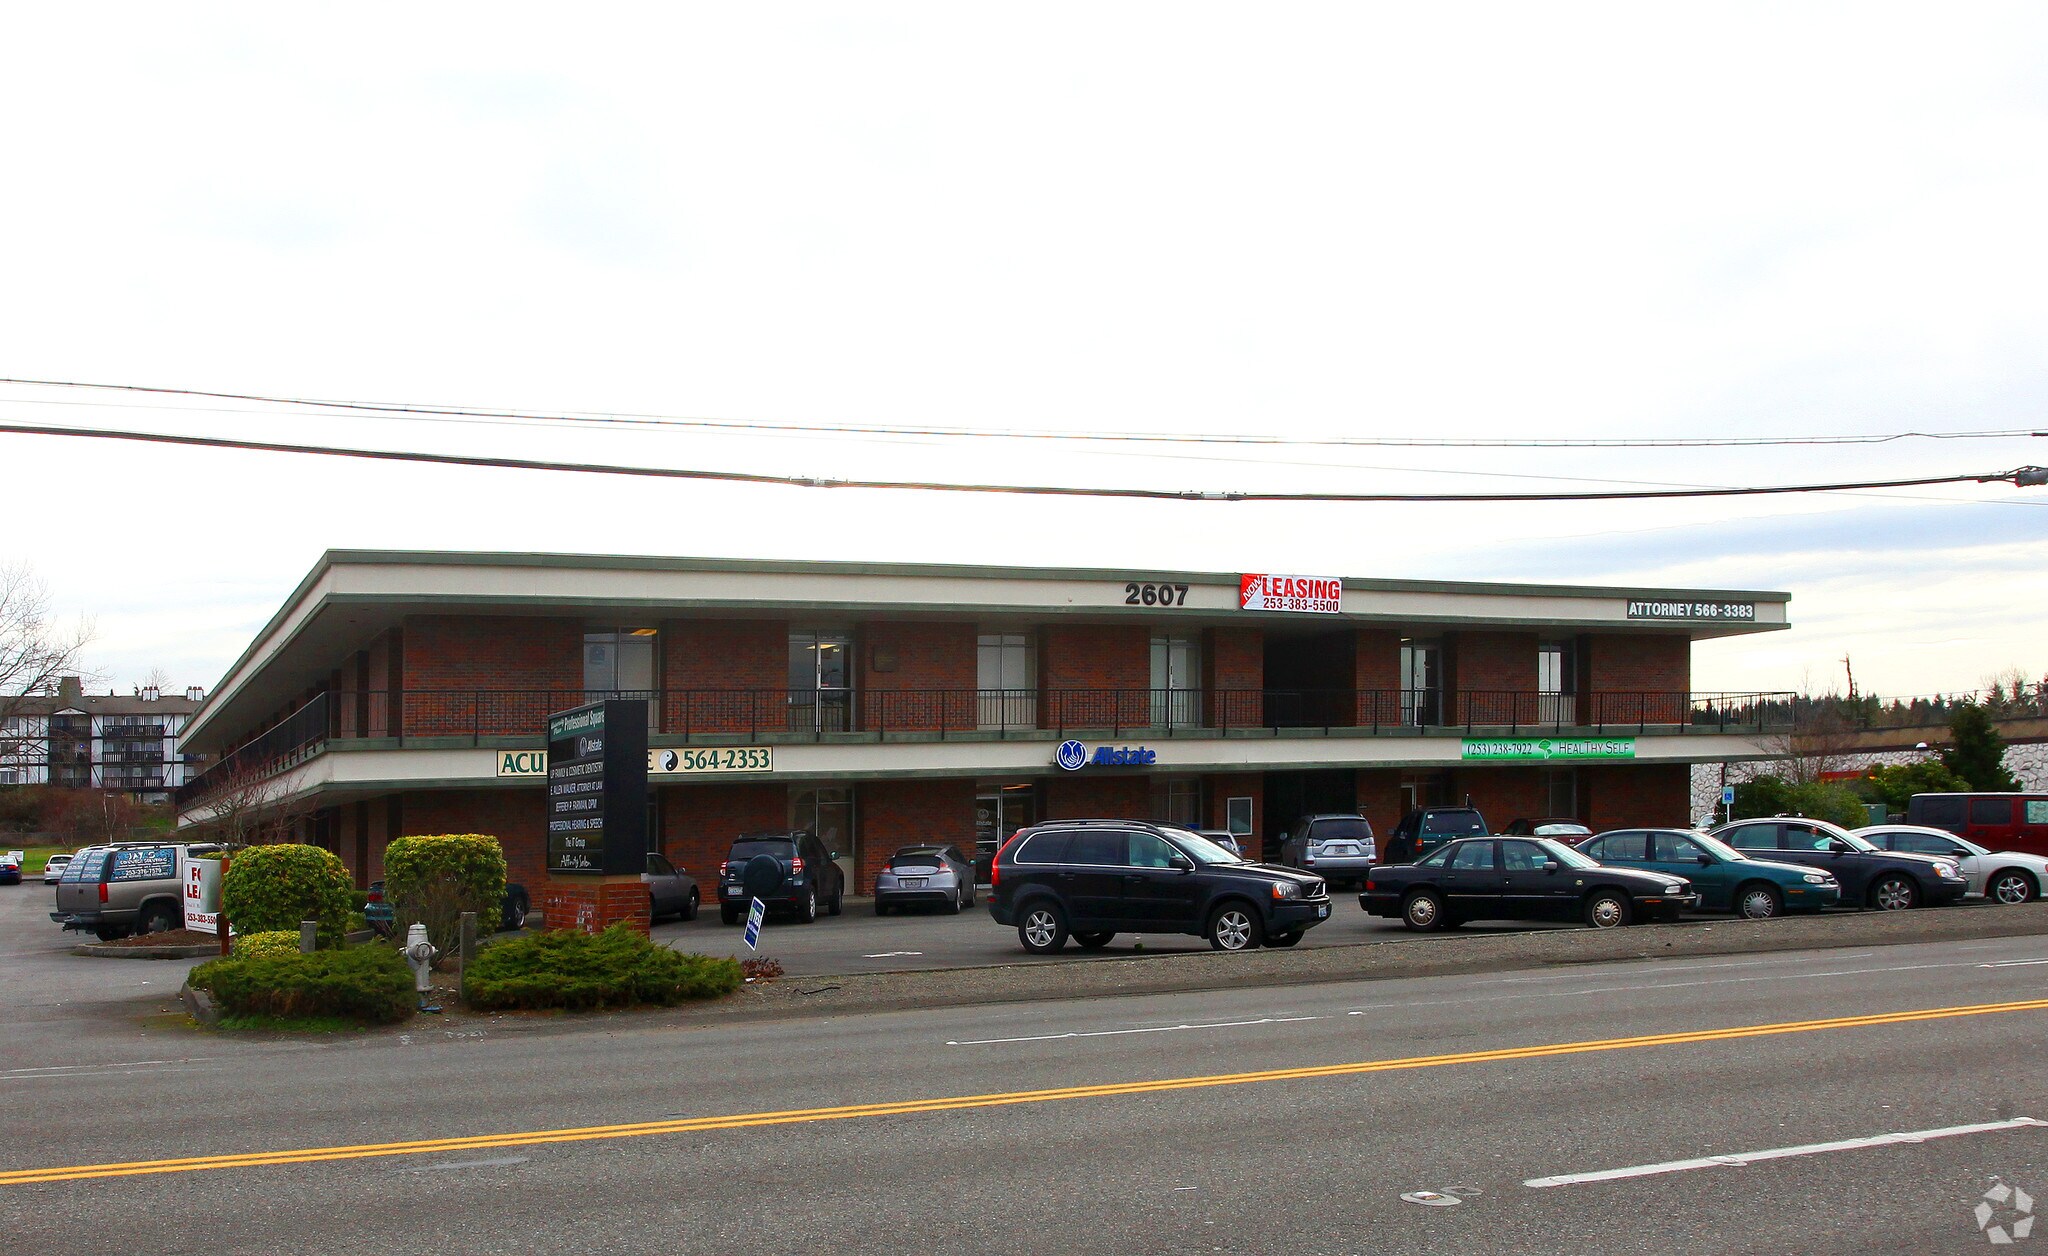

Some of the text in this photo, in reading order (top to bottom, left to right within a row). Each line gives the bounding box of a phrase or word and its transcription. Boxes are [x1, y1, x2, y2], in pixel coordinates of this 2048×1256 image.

[1125, 583, 1189, 606] 2607
[1242, 575, 1262, 601] NOW
[1262, 577, 1341, 600] LEASING
[1263, 597, 1339, 612] 253-383-5500
[1628, 602, 1753, 618] ATTORNEY 566-3383
[564, 711, 590, 731] Professional
[587, 739, 602, 752] Allstate
[1467, 743, 1491, 756] (253)
[1492, 743, 1533, 755] 238-7922
[684, 750, 770, 770] 564-2353
[1090, 746, 1157, 765] Allstate
